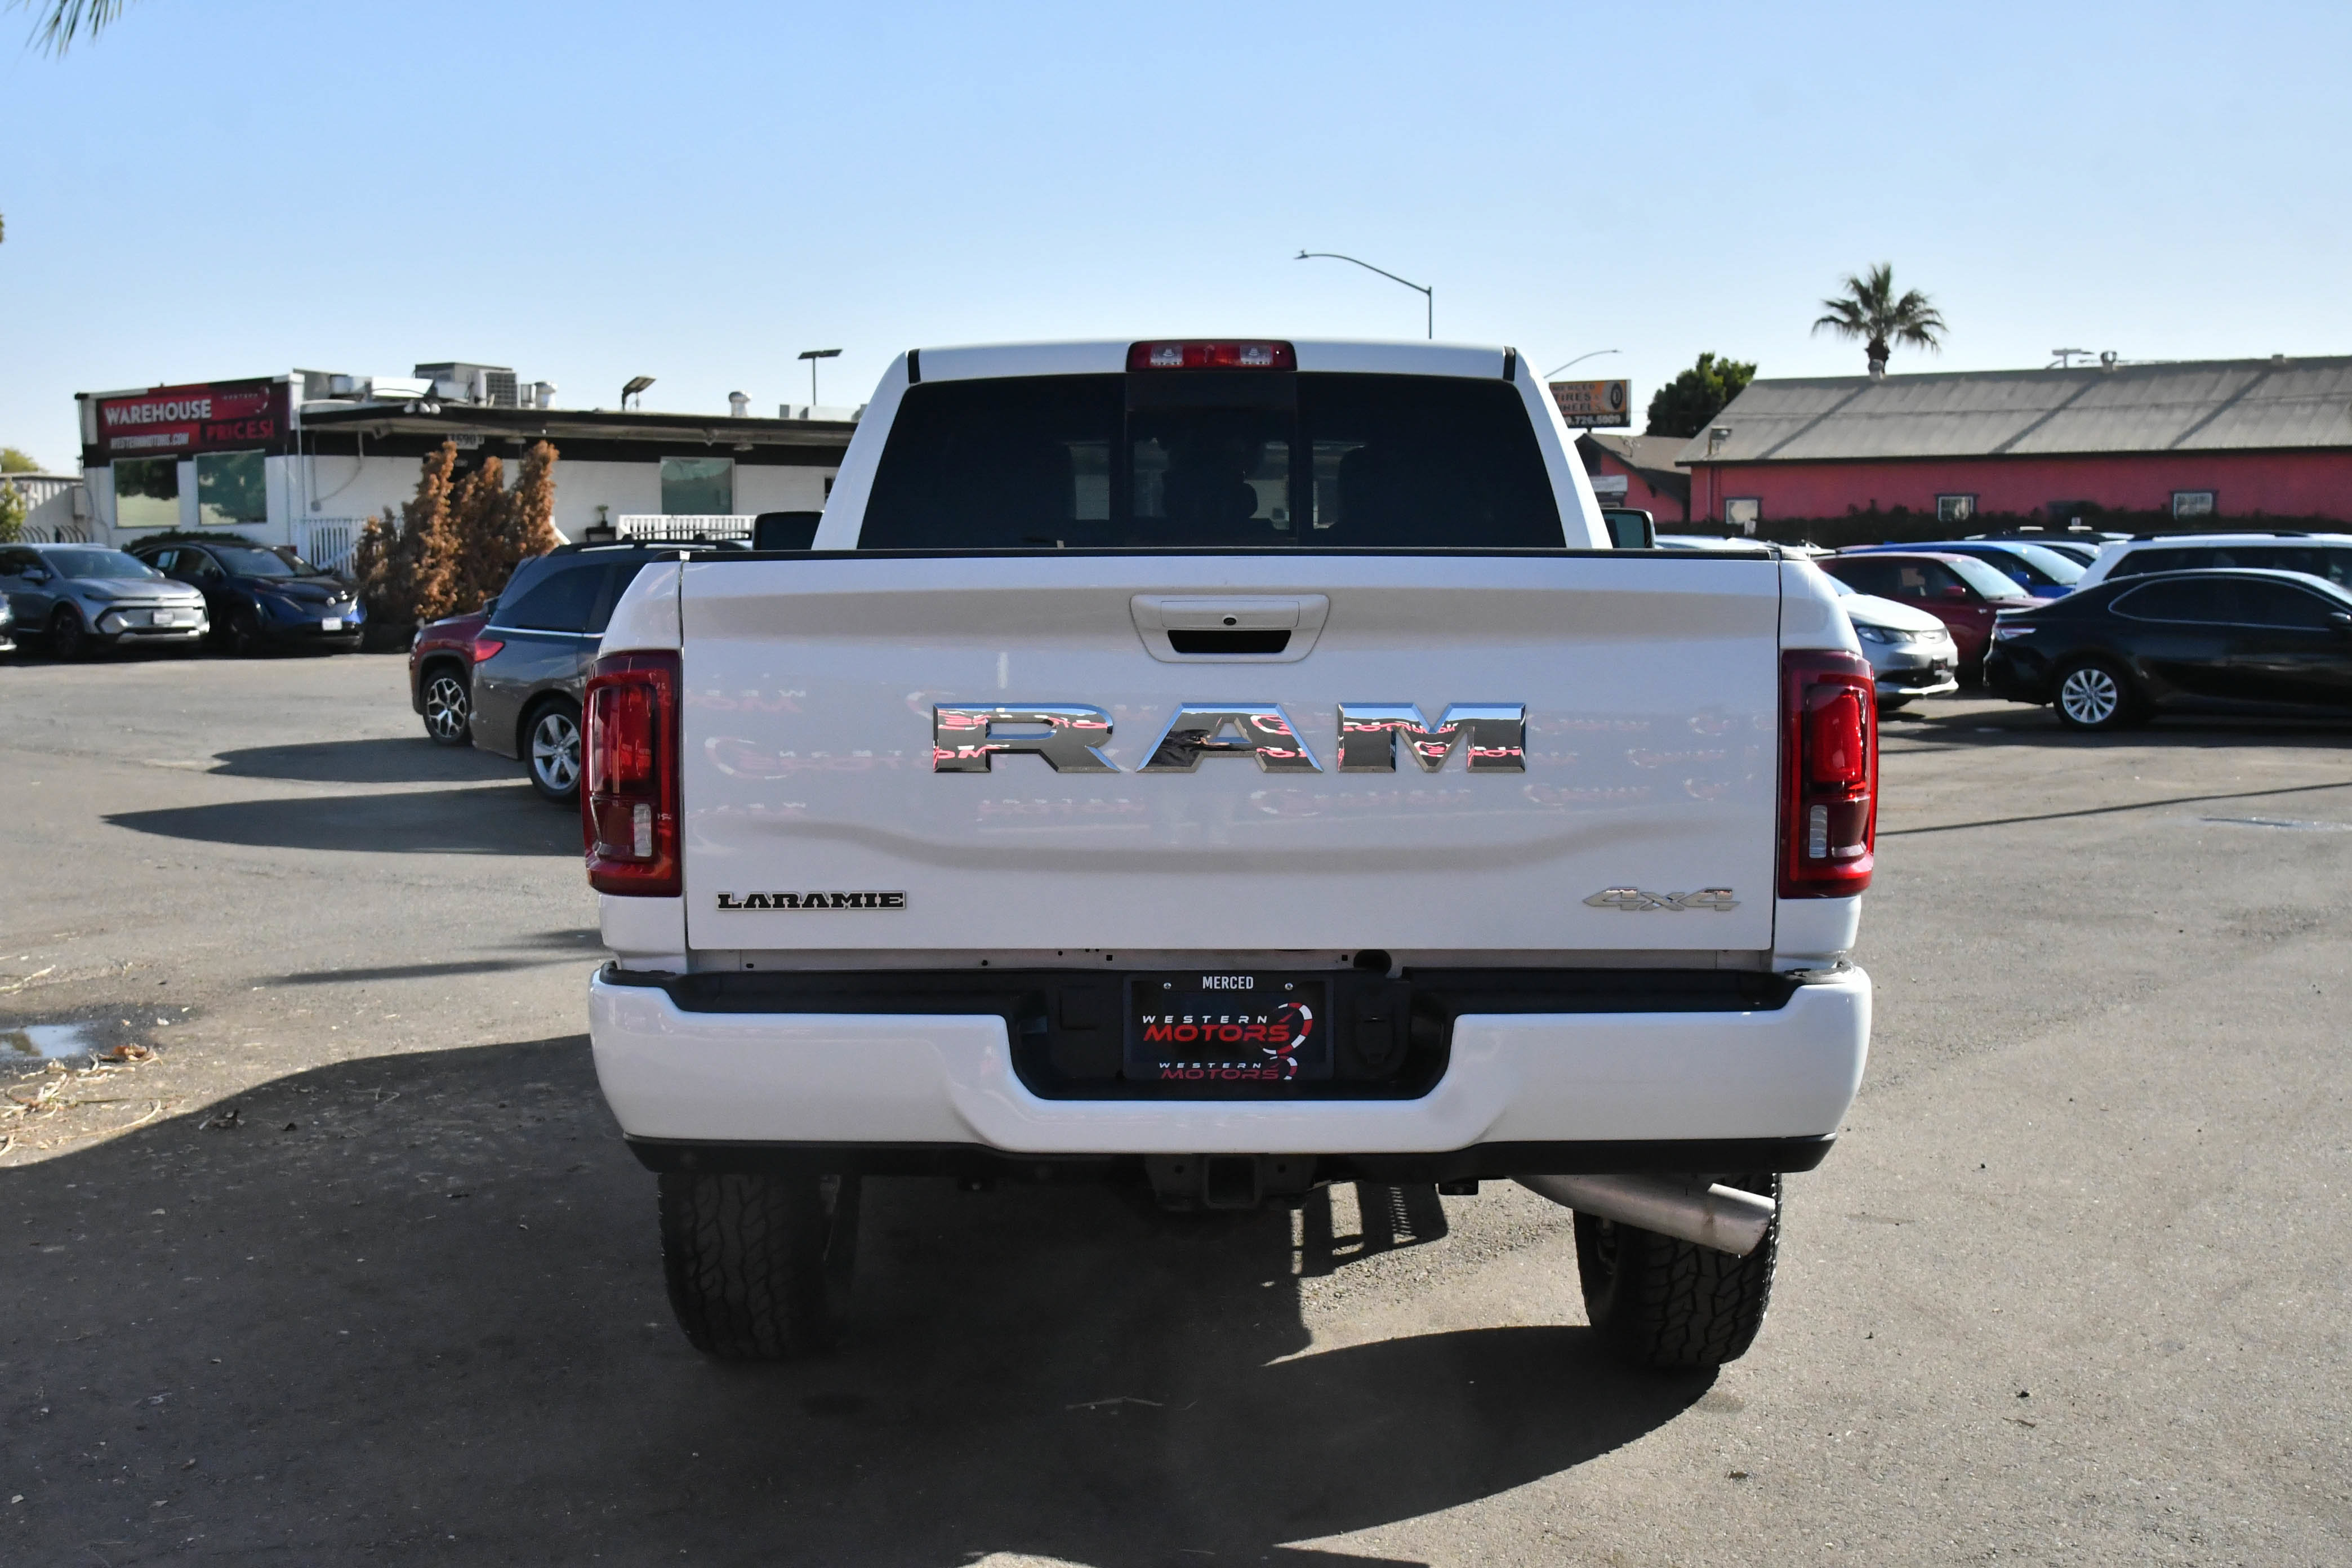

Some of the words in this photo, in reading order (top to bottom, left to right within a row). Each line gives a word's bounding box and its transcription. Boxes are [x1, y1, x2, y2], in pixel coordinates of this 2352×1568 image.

[105, 399, 212, 426] WAREHOUSE
[206, 418, 274, 440] PRICES!
[934, 702, 1525, 773] RAM
[717, 891, 905, 910] LARAMIE
[1202, 975, 1254, 990] MERCED
[1142, 1015, 1267, 1023] WESTERN
[1143, 1024, 1290, 1041] MOTORS
[1160, 1068, 1280, 1080] MOTORS
